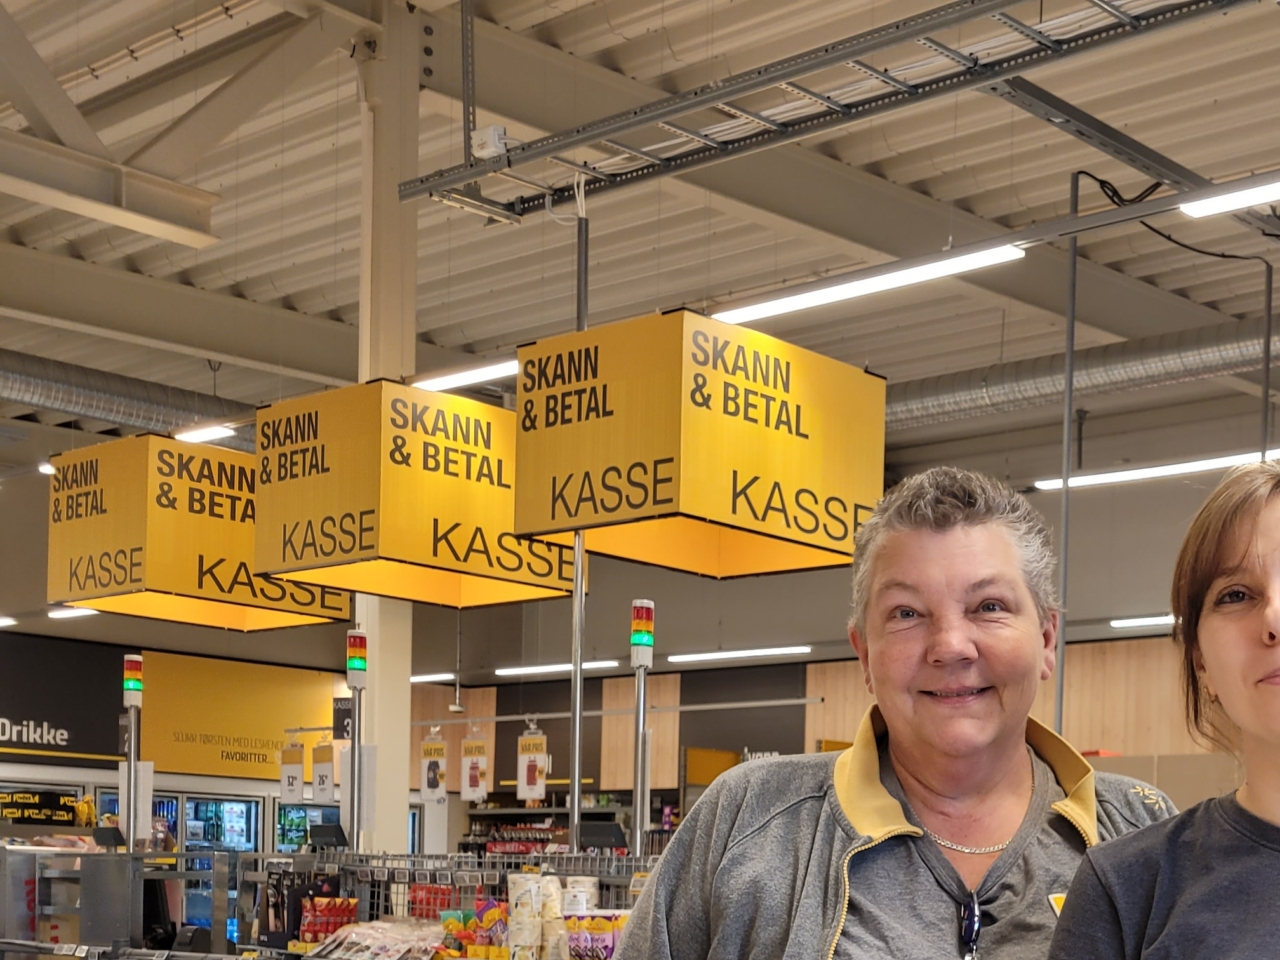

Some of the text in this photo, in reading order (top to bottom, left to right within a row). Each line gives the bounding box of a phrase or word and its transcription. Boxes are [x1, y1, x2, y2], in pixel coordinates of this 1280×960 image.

[523, 346, 599, 393] SKANN
[691, 330, 792, 394] SKANN
[390, 398, 492, 450] SKANN
[521, 384, 614, 432] & BETAL
[690, 373, 810, 440] & BETAL
[260, 410, 319, 451] SKANN
[52, 458, 98, 493] SKANN
[157, 450, 256, 494] SKANN
[260, 444, 330, 485] & BETAL
[389, 435, 512, 489] & BETAL
[52, 489, 108, 523] & BETAL
[156, 481, 256, 525] & BETA
[551, 457, 675, 521] KASSE
[282, 509, 375, 563] KASSE
[432, 518, 575, 582] KASSE
[69, 546, 144, 592] KASSE
[0, 718, 69, 746] Drikke
[344, 718, 352, 739] 3
